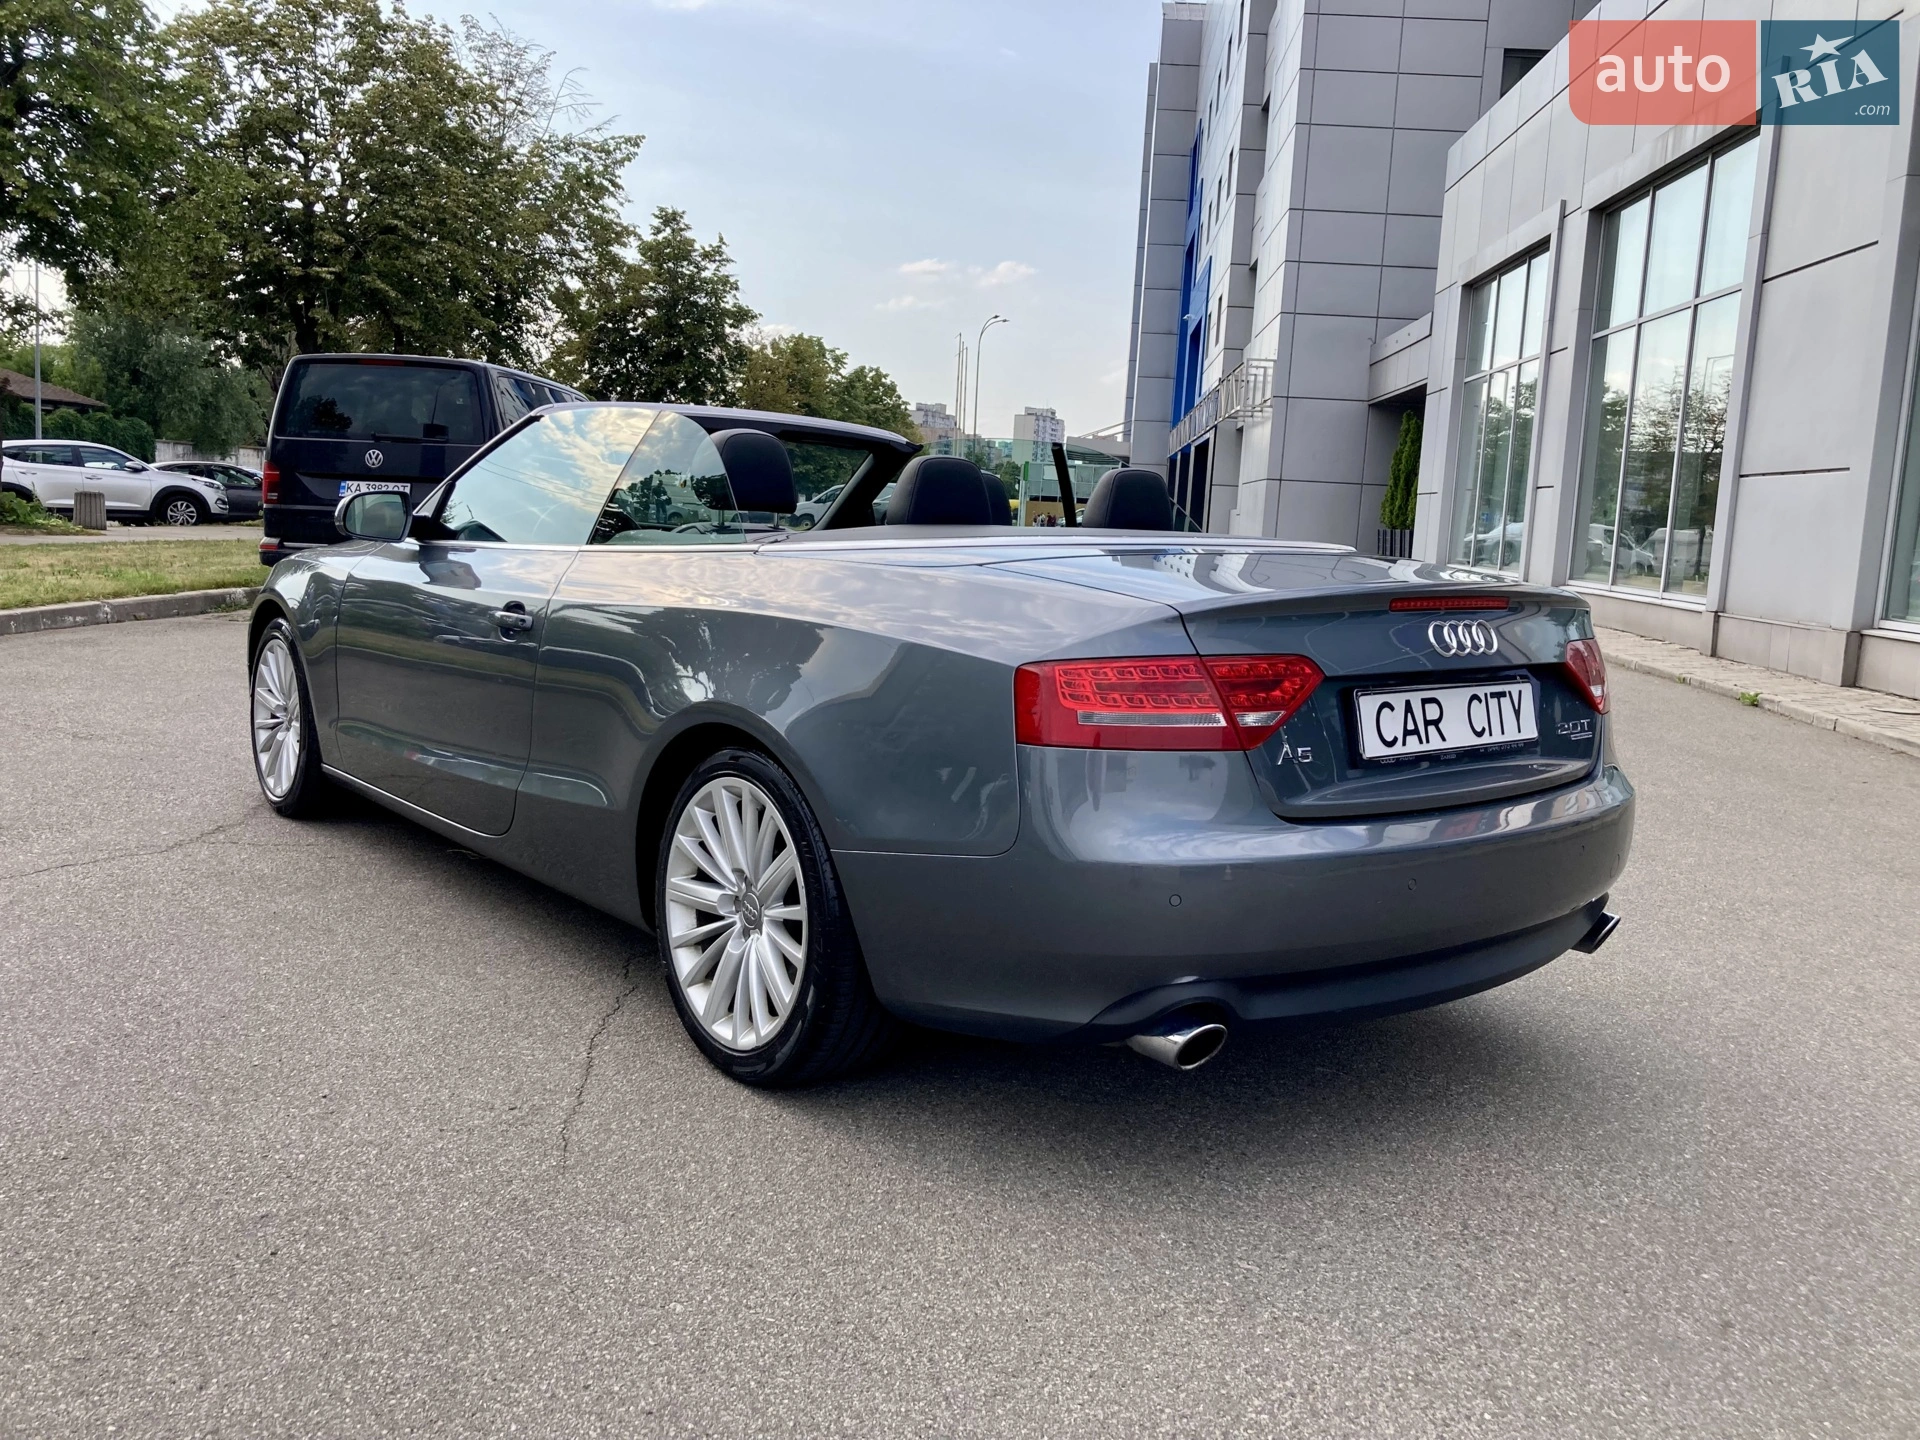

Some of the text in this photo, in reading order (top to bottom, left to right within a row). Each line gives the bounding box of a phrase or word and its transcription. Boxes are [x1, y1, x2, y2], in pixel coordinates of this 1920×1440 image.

[346, 483, 362, 493] KA
[1375, 689, 1523, 748] CAR CITY
[1276, 741, 1313, 766] A5
